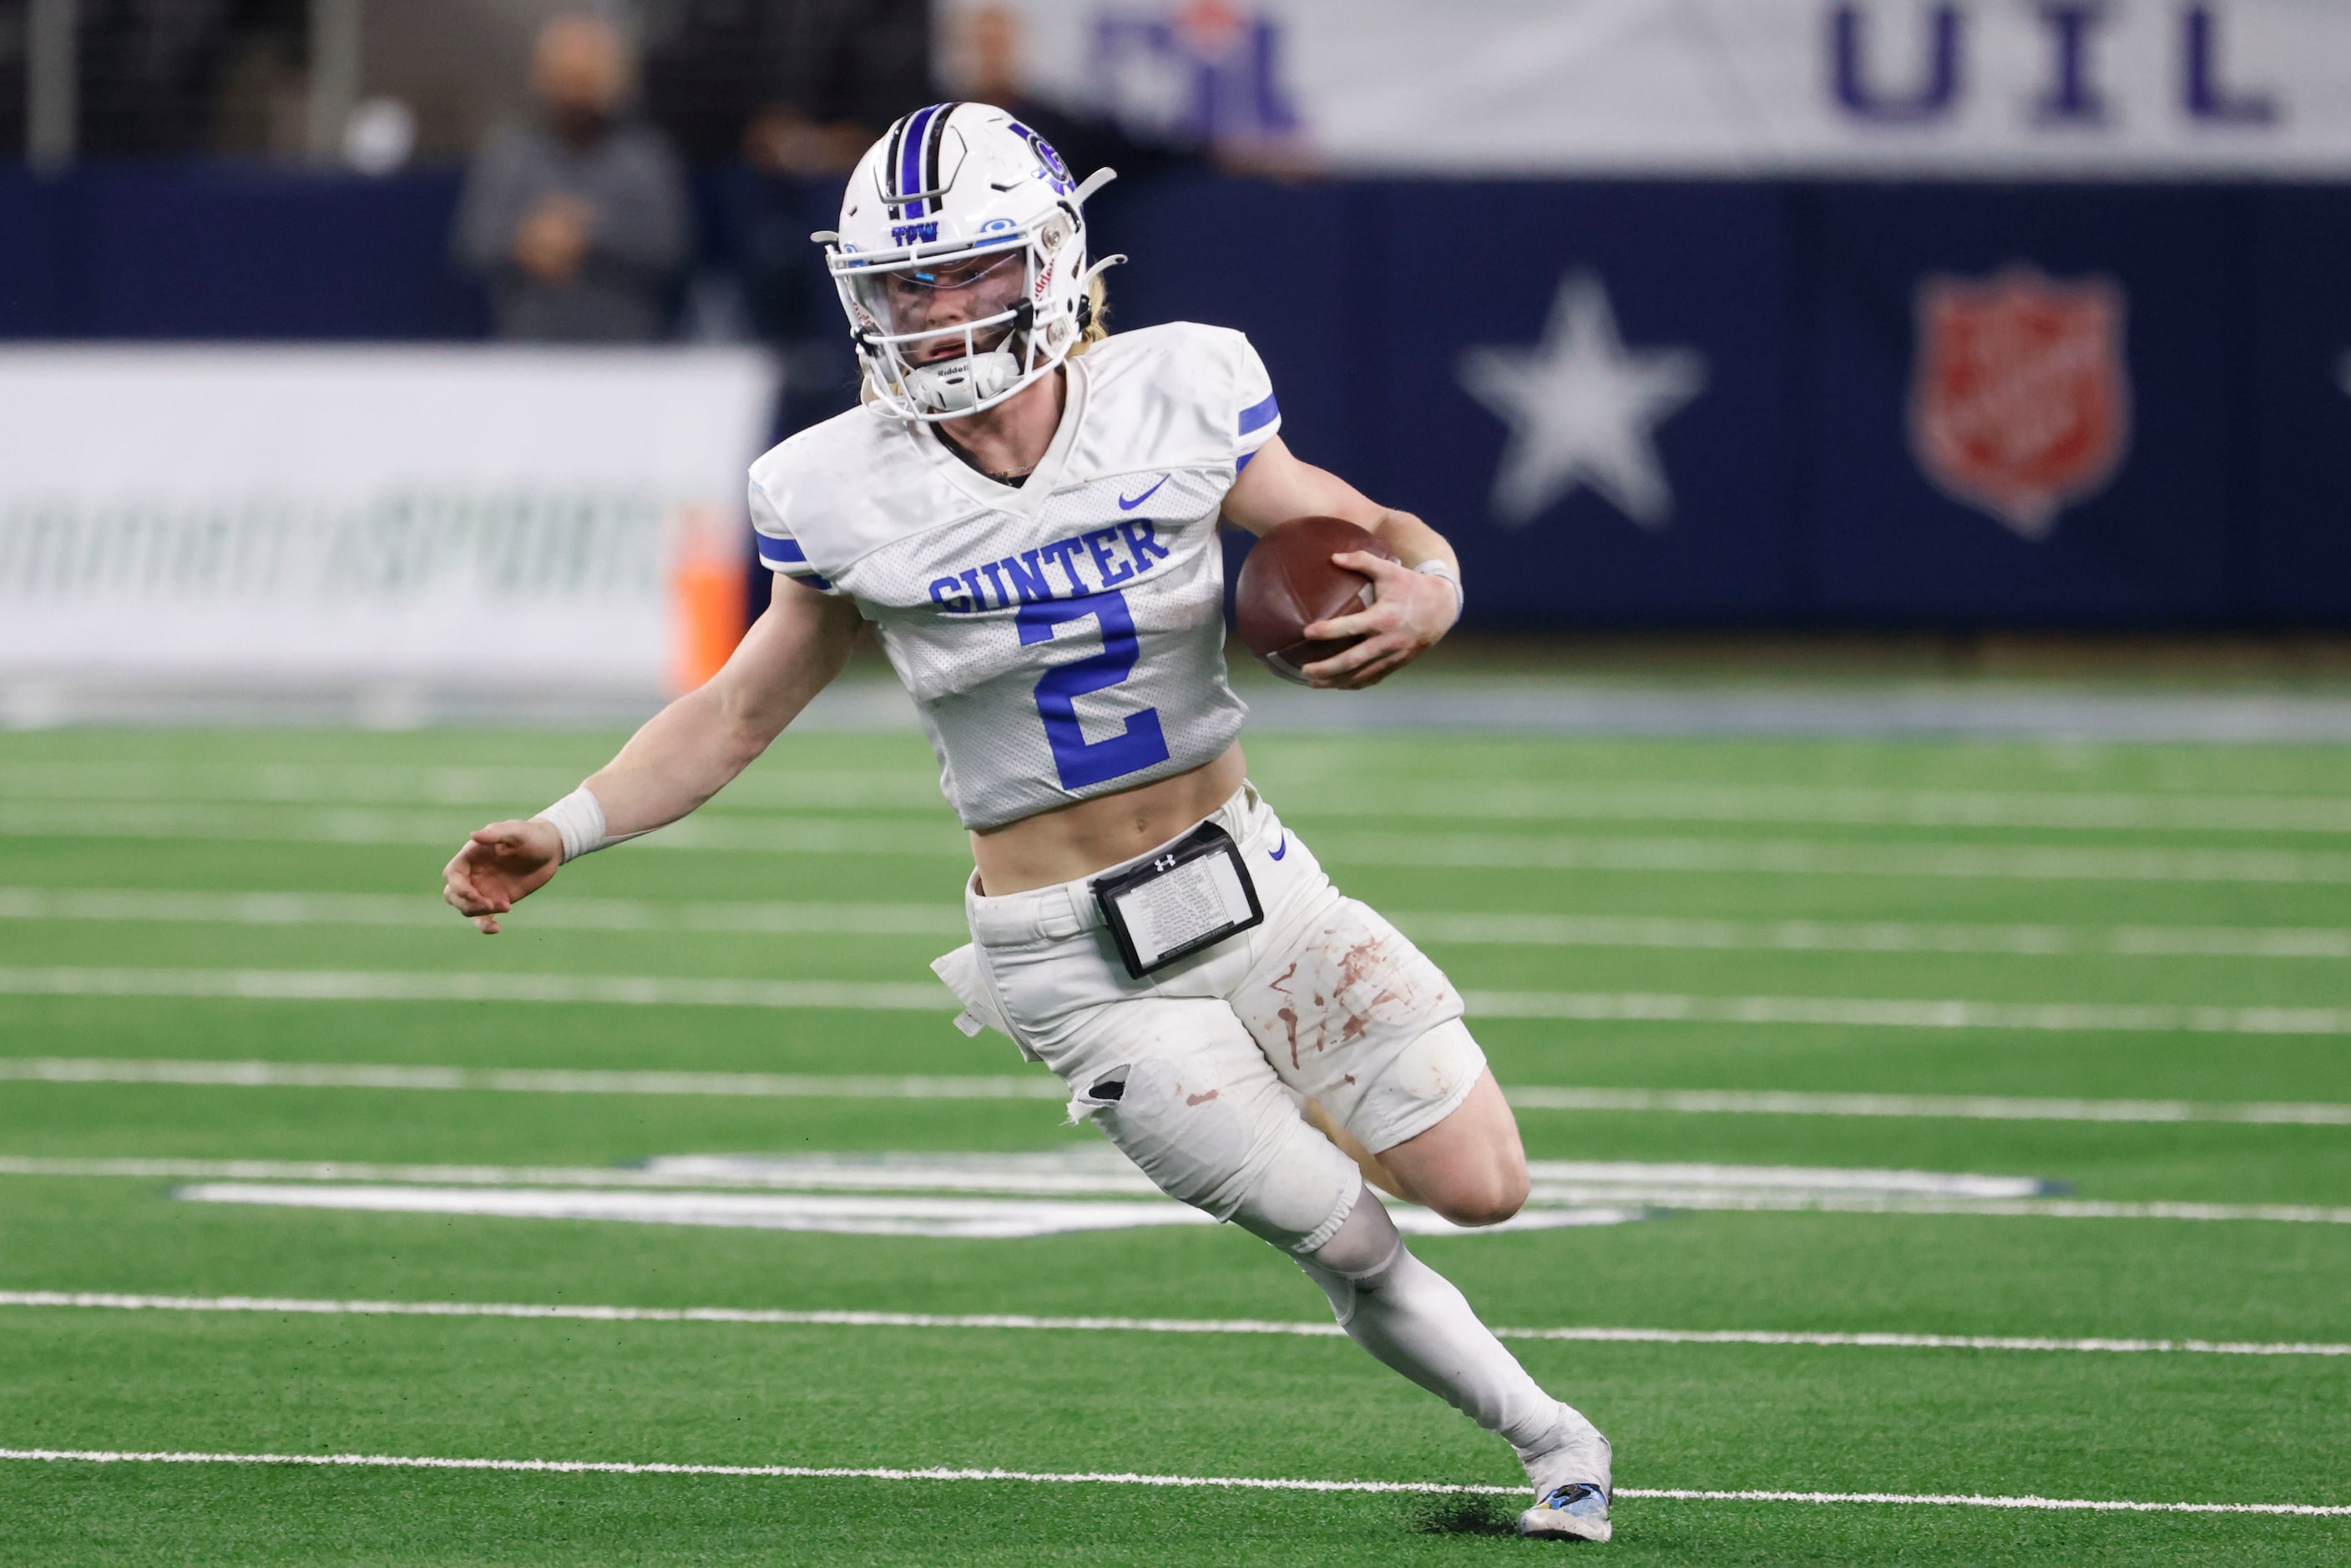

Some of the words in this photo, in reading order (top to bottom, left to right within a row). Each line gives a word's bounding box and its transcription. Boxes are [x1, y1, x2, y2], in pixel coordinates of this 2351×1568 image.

[1825, 3, 2277, 125] UIL
[891, 220, 938, 248] TPW
[928, 518, 1170, 614] GUNTER
[1014, 589, 1170, 791] 2
